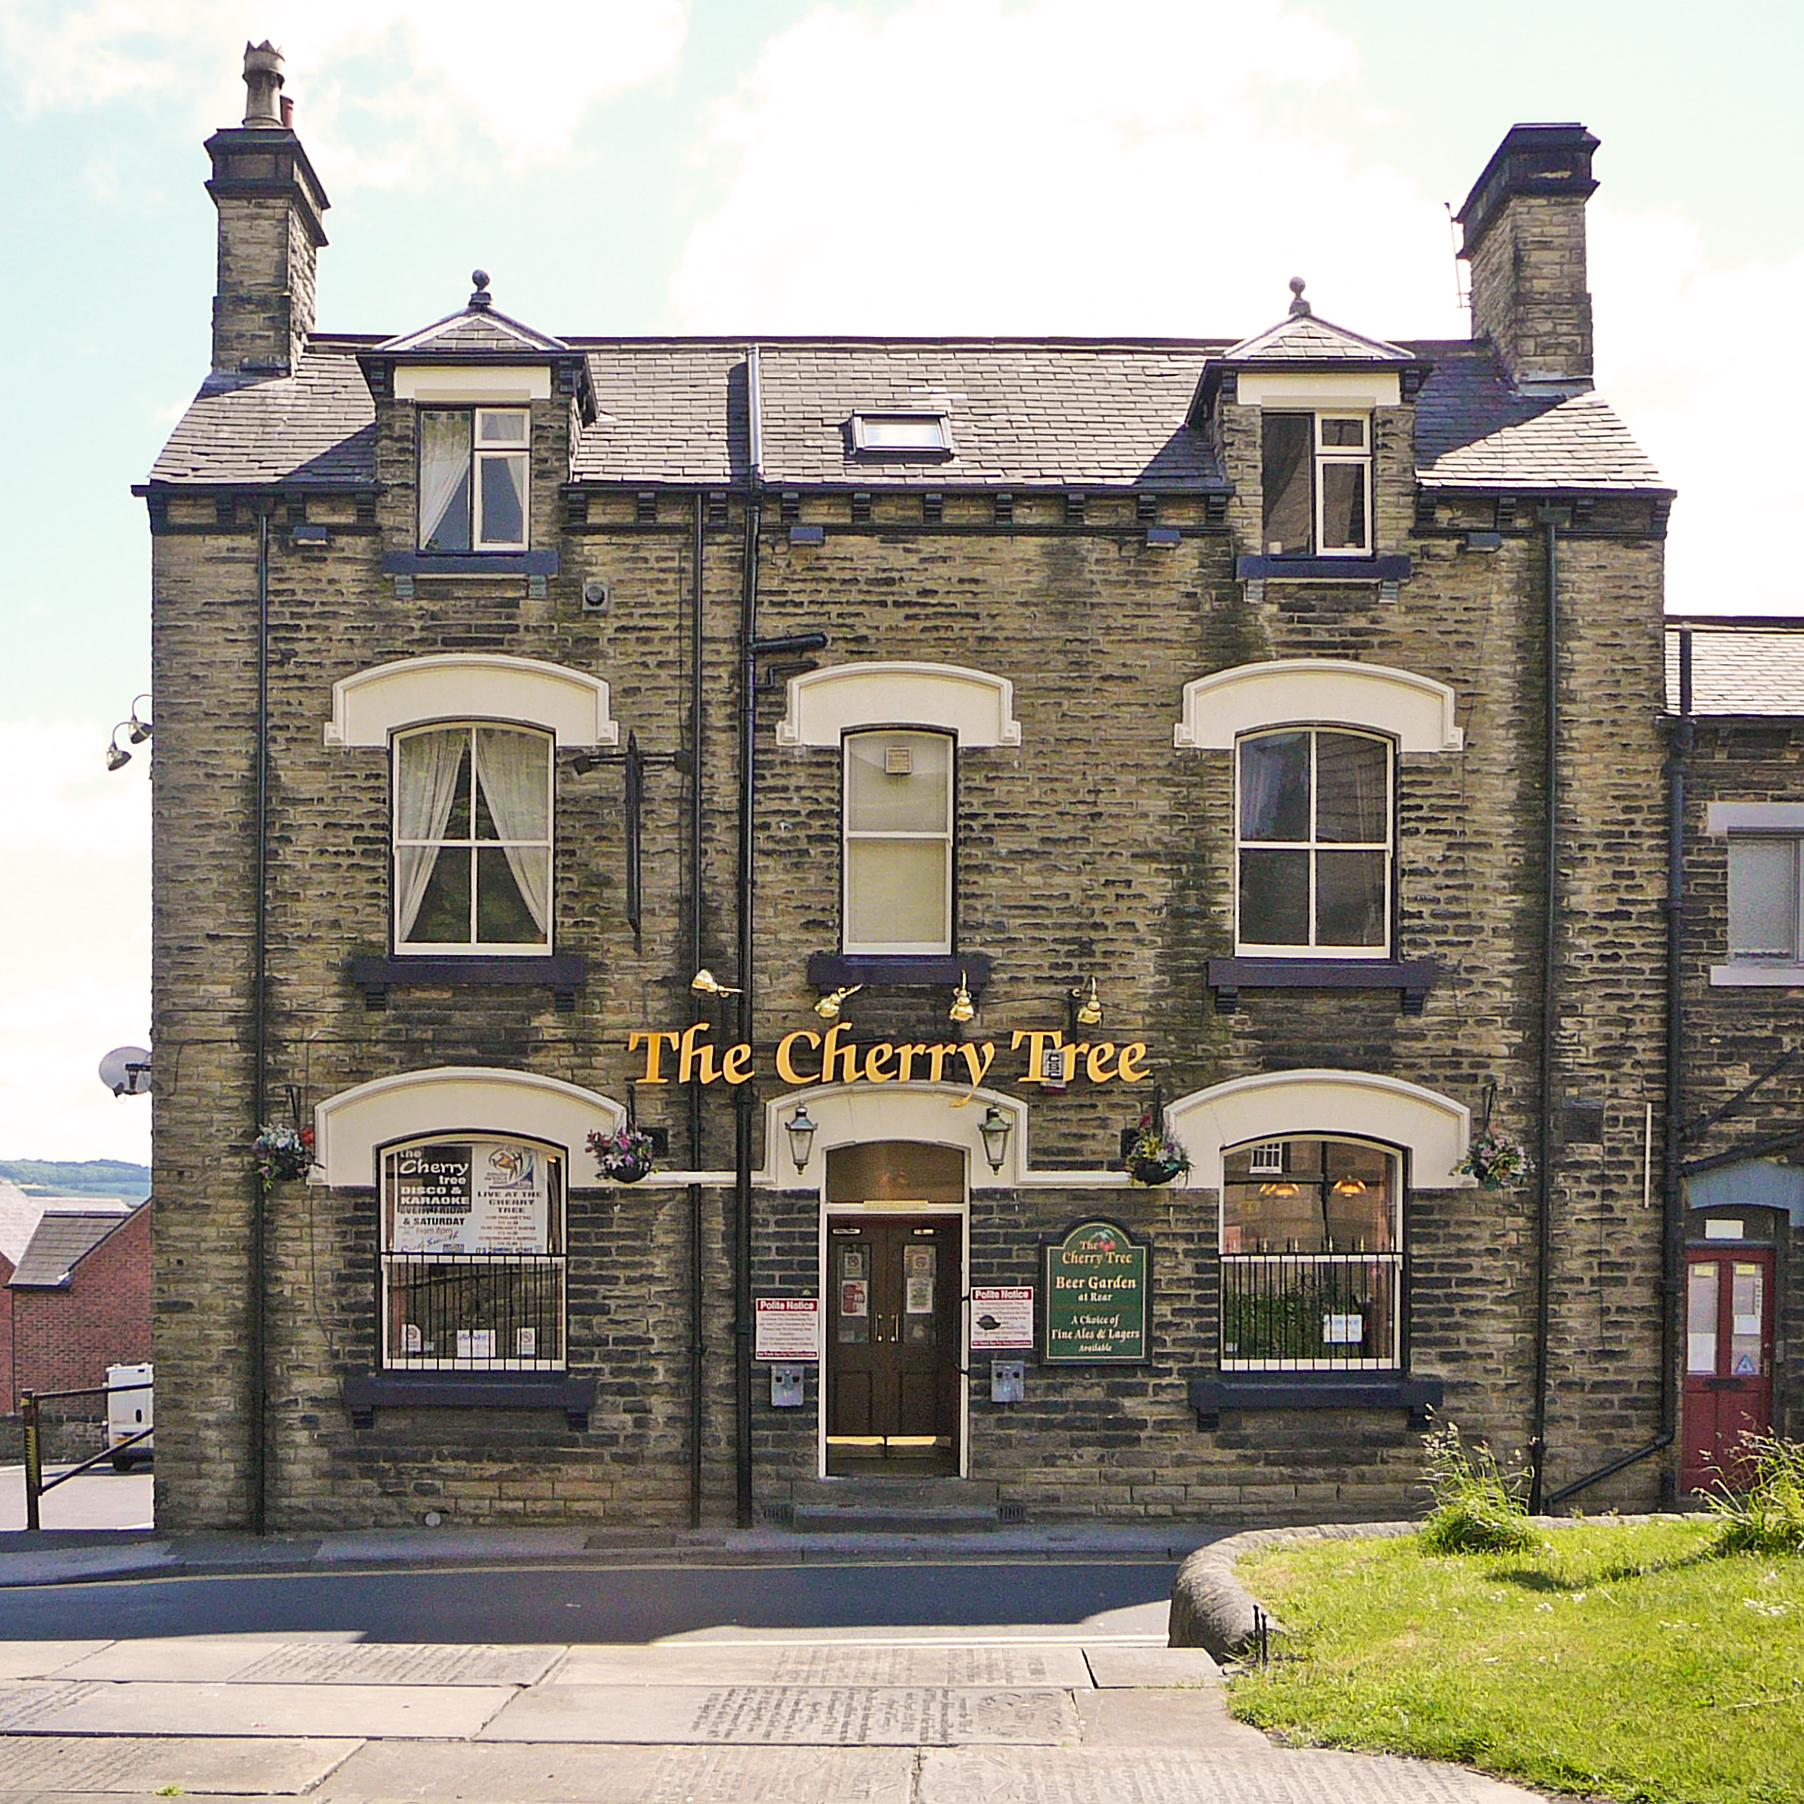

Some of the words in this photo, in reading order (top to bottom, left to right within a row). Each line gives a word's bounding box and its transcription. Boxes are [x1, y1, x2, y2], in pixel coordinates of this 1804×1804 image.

[628, 1022, 755, 1085] The
[776, 1022, 995, 1108] Cherry
[1011, 1029, 1151, 1083] Tree
[400, 1159, 469, 1176] Cherry
[438, 1174, 467, 1185] tree
[401, 1186, 447, 1195] DISCO
[450, 1186, 462, 1195] &
[400, 1196, 470, 1205] KARAOKE
[403, 1217, 411, 1226] &
[414, 1217, 465, 1226] SATURDAY
[1079, 1240, 1098, 1250] The
[1062, 1250, 1102, 1269] Cherry
[1105, 1251, 1133, 1264] Tree
[1056, 1276, 1085, 1289] Beer
[1087, 1274, 1137, 1290] Garden
[974, 1289, 1000, 1299] Polite
[1001, 1289, 1029, 1299] Notice
[1078, 1293, 1088, 1301] at
[1090, 1292, 1113, 1302] Rear
[760, 1300, 785, 1310] Polite
[786, 1300, 815, 1310] Notice
[1070, 1315, 1078, 1325] A
[1079, 1314, 1109, 1325] Choice
[1109, 1313, 1120, 1328] of
[1051, 1329, 1073, 1340] Fine
[1074, 1327, 1095, 1340] Ales
[1096, 1328, 1106, 1340] &
[1108, 1328, 1141, 1343] Lagers
[1078, 1342, 1113, 1353] Available
